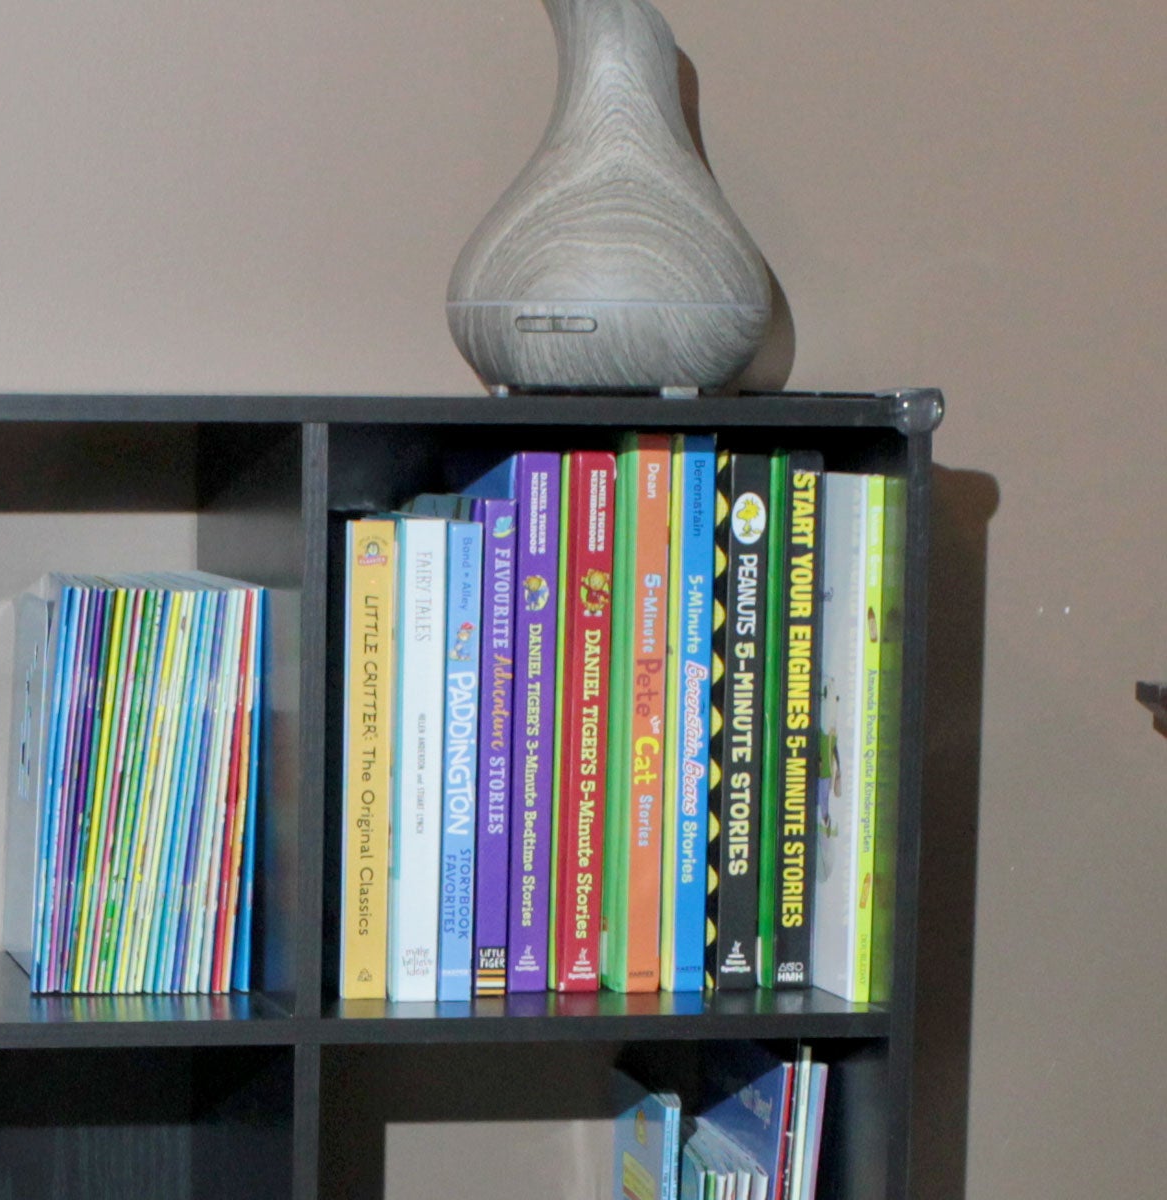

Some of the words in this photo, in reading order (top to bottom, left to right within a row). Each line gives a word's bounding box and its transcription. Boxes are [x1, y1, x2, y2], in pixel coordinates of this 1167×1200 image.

[538, 472, 549, 510] DANIEL
[598, 469, 608, 510] DANIEL
[647, 463, 660, 499] Dean
[692, 459, 706, 538] Berenstain
[791, 471, 817, 549] START
[415, 551, 432, 592] FAIRY
[461, 537, 473, 568] Bond
[789, 552, 814, 618] YOUR
[363, 595, 379, 654] LITTLE
[414, 598, 431, 642] TALES
[459, 582, 472, 611] Alley
[492, 547, 512, 649] FAVOURITE
[642, 573, 662, 654] 5-Minute
[686, 574, 703, 655] 5-Minute
[735, 553, 758, 636] PEANUTS
[527, 623, 543, 679] DANIEL
[583, 629, 601, 701] DANIEL
[786, 625, 812, 730] ENGINES
[491, 653, 514, 752] Adventure
[526, 681, 541, 737] TIGER'S
[636, 658, 663, 718] Pete
[683, 660, 708, 761] Berenstain
[731, 641, 755, 763] 5-MINUTE
[864, 669, 878, 710] Amanda
[361, 747, 376, 782] The
[446, 671, 476, 836] PADDINGTON
[580, 704, 600, 776] TIGER'S
[633, 735, 661, 786] Cat
[864, 714, 878, 747] Panda
[487, 756, 506, 835] STORIES
[524, 740, 539, 808] 3-Minute
[681, 760, 705, 818] Bears
[783, 735, 808, 837] 5-MINUTE
[357, 789, 375, 860] Original
[522, 810, 538, 872] Bedtime
[577, 780, 596, 868] 5-Minute
[637, 794, 654, 848] Stories
[728, 772, 750, 877] STORIES
[860, 781, 875, 854] Kindergarten
[680, 821, 698, 885] Stories
[781, 841, 805, 929] STORIES
[358, 867, 374, 936] Classics
[443, 854, 457, 935] FAVORITES
[458, 848, 472, 940] STORYBOOK
[521, 875, 536, 927] Stories
[575, 872, 593, 940] Stories
[479, 948, 506, 958] LITTLE
[479, 957, 506, 969] TIGER
[777, 972, 804, 983] HMH
